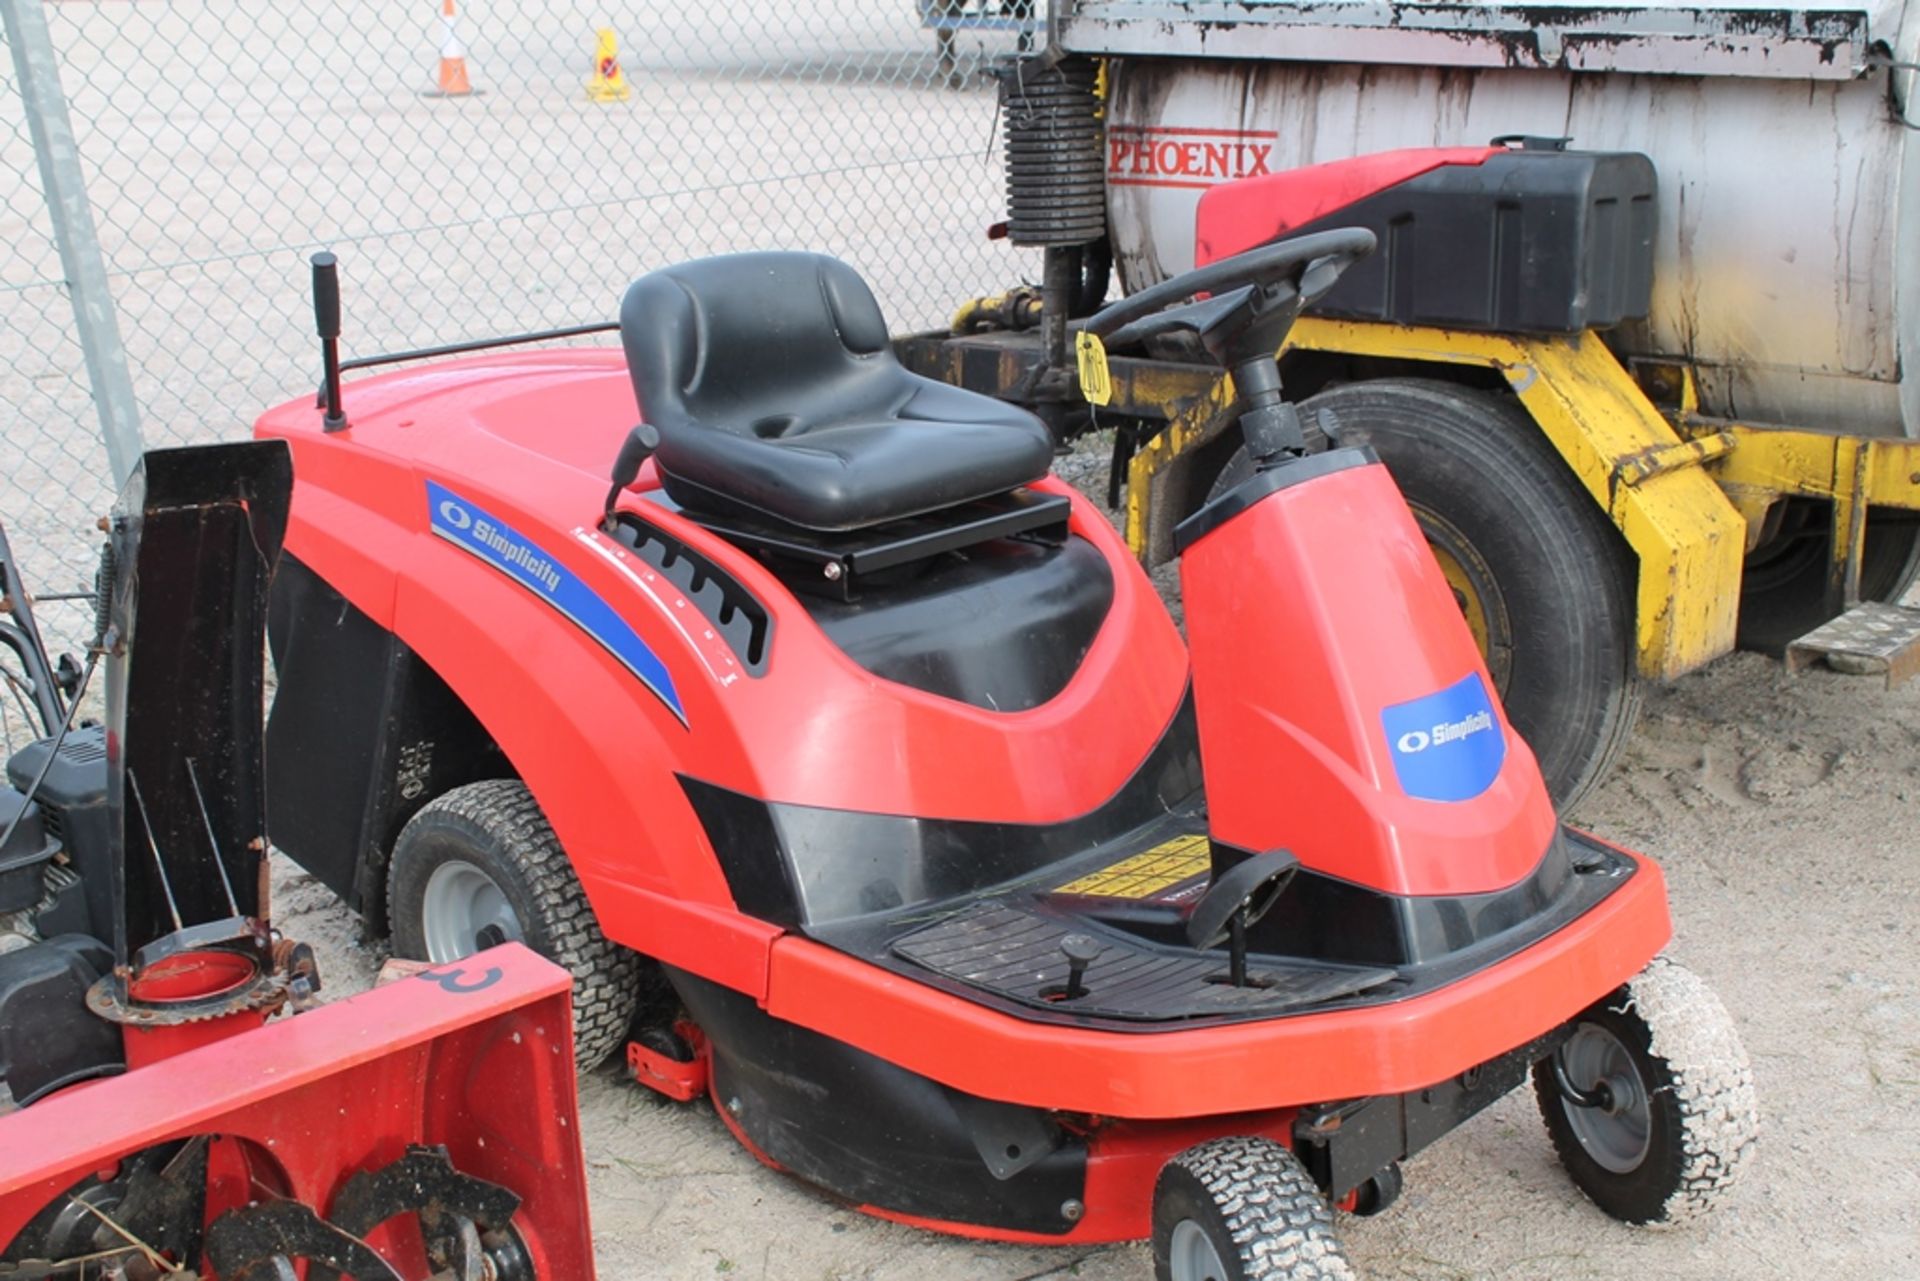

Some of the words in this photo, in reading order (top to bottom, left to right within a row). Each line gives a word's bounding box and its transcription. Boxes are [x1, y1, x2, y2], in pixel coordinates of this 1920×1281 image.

[1108, 138, 1272, 178] PHOENIX
[472, 519, 560, 592] Simplicity
[1432, 710, 1493, 745] Simplicity
